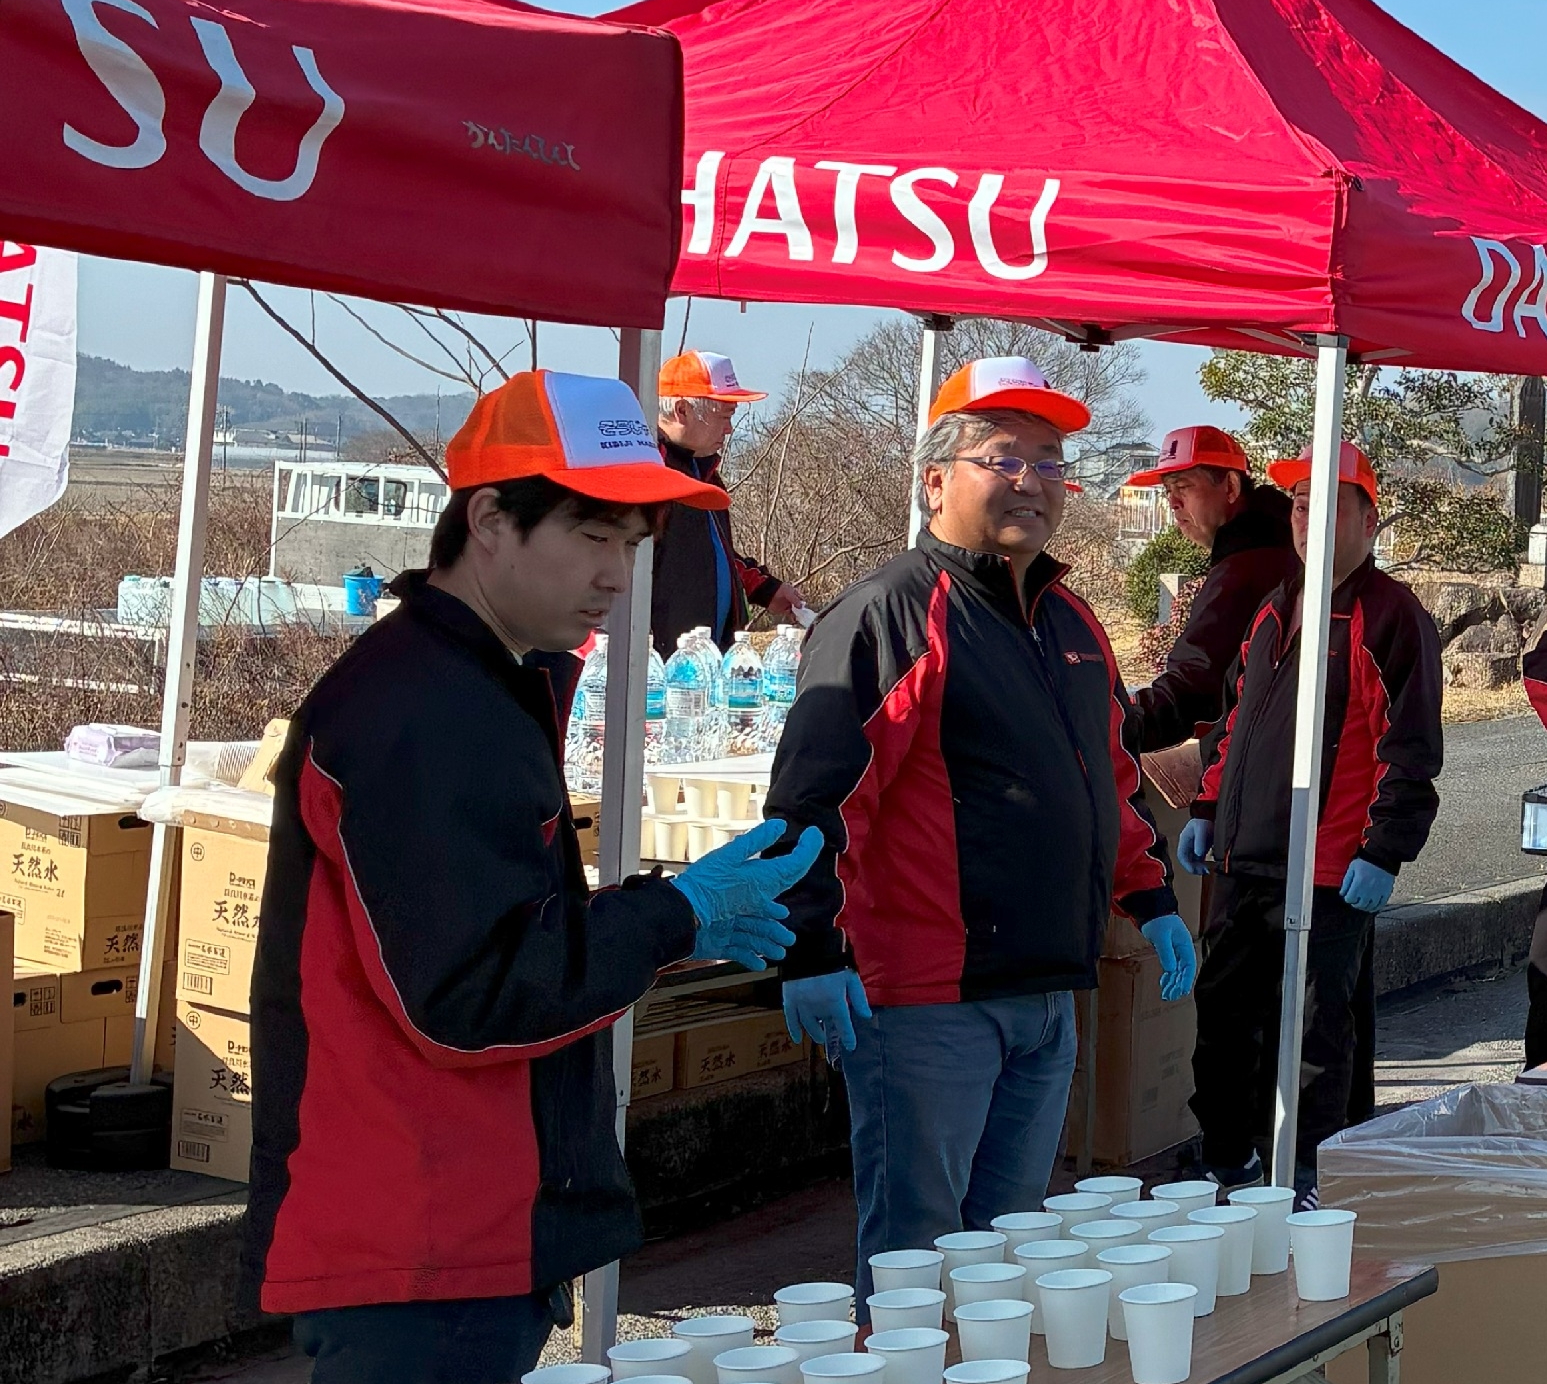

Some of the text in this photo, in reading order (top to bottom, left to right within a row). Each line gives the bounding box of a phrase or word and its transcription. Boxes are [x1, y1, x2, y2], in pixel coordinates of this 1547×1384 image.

[681, 151, 1061, 280] HATSU
[11, 853, 59, 882] 天然水
[700, 1051, 736, 1073] 天然水
